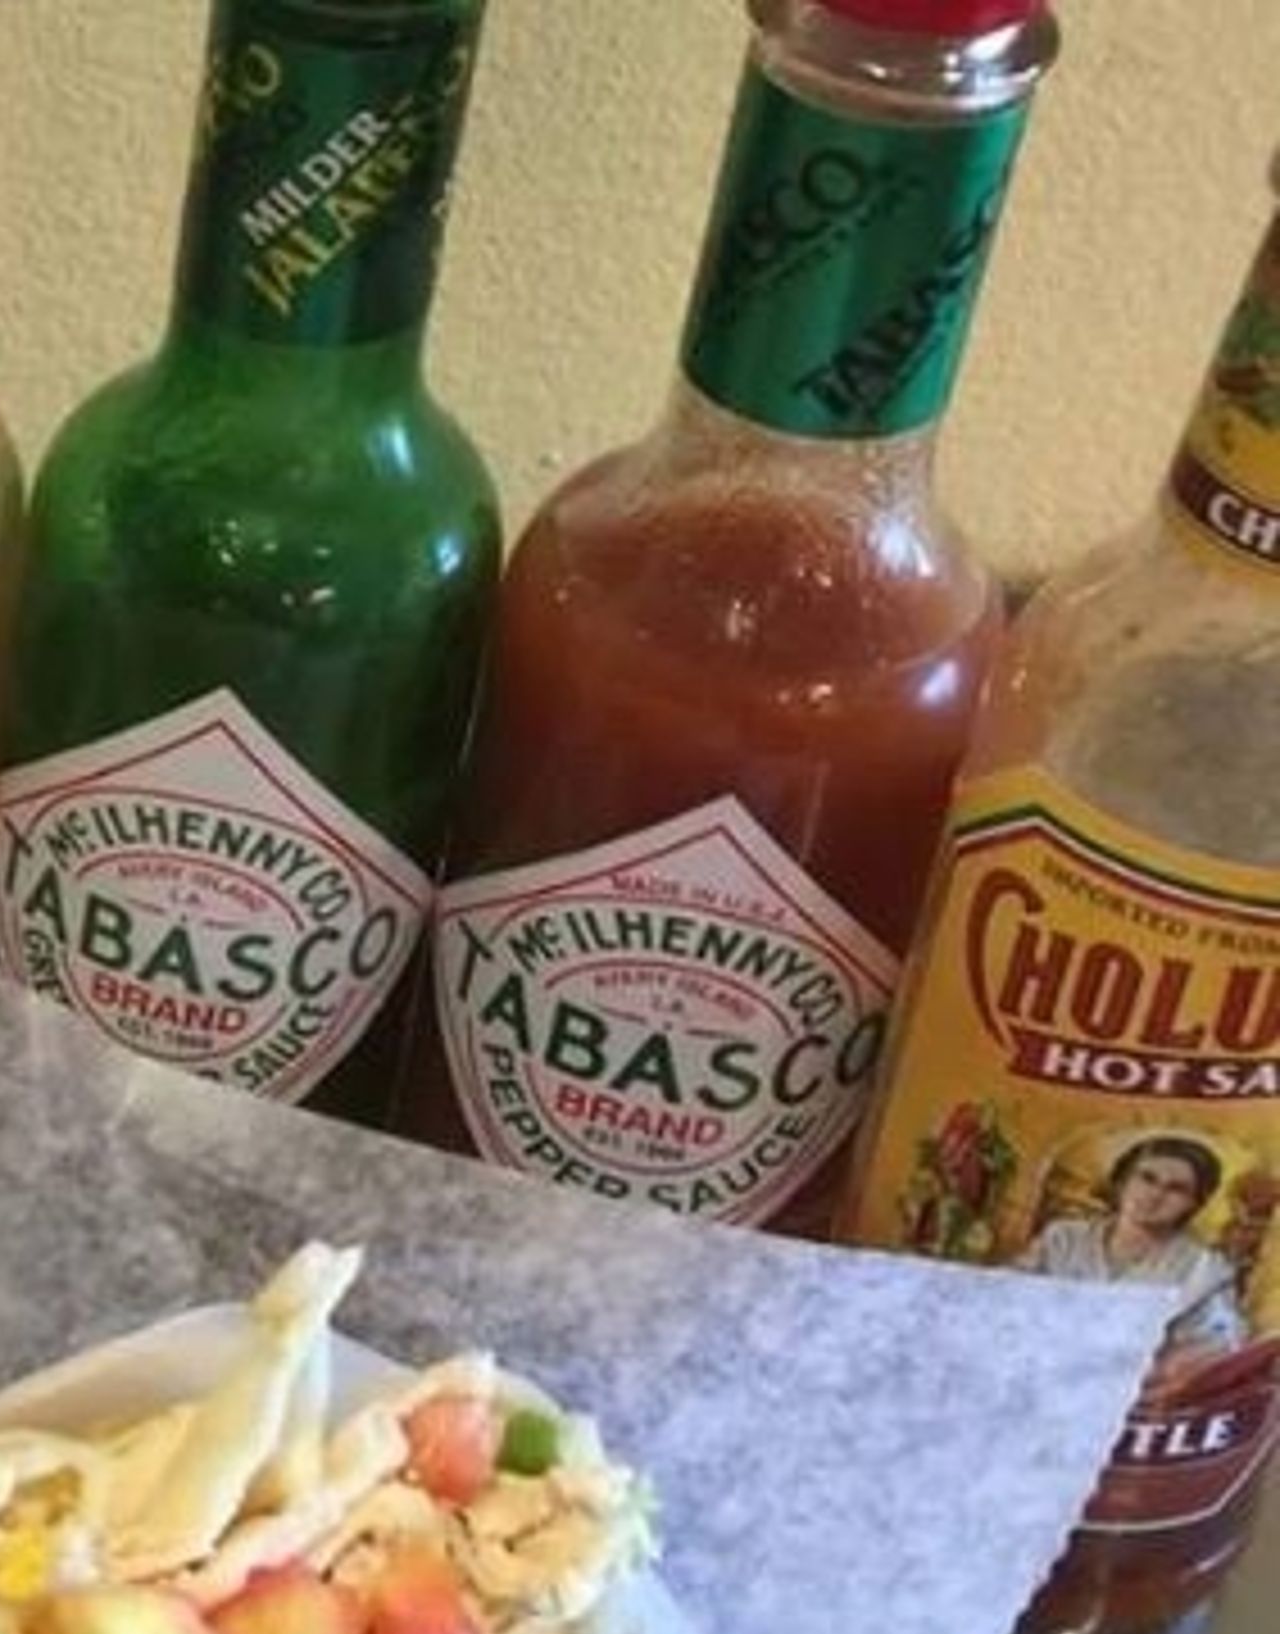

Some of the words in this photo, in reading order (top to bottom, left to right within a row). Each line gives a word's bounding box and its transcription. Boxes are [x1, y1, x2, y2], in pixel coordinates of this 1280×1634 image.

[238, 110, 390, 247] MILDER
[3, 815, 398, 1001] TABASCO
[91, 971, 248, 1036] BRAND
[233, 1000, 336, 1091] SAUCE
[458, 918, 889, 1111] TABASCO
[555, 1085, 725, 1147] BRAND
[1042, 1043, 1186, 1094] HOT
[647, 1113, 817, 1214] SAUCE
